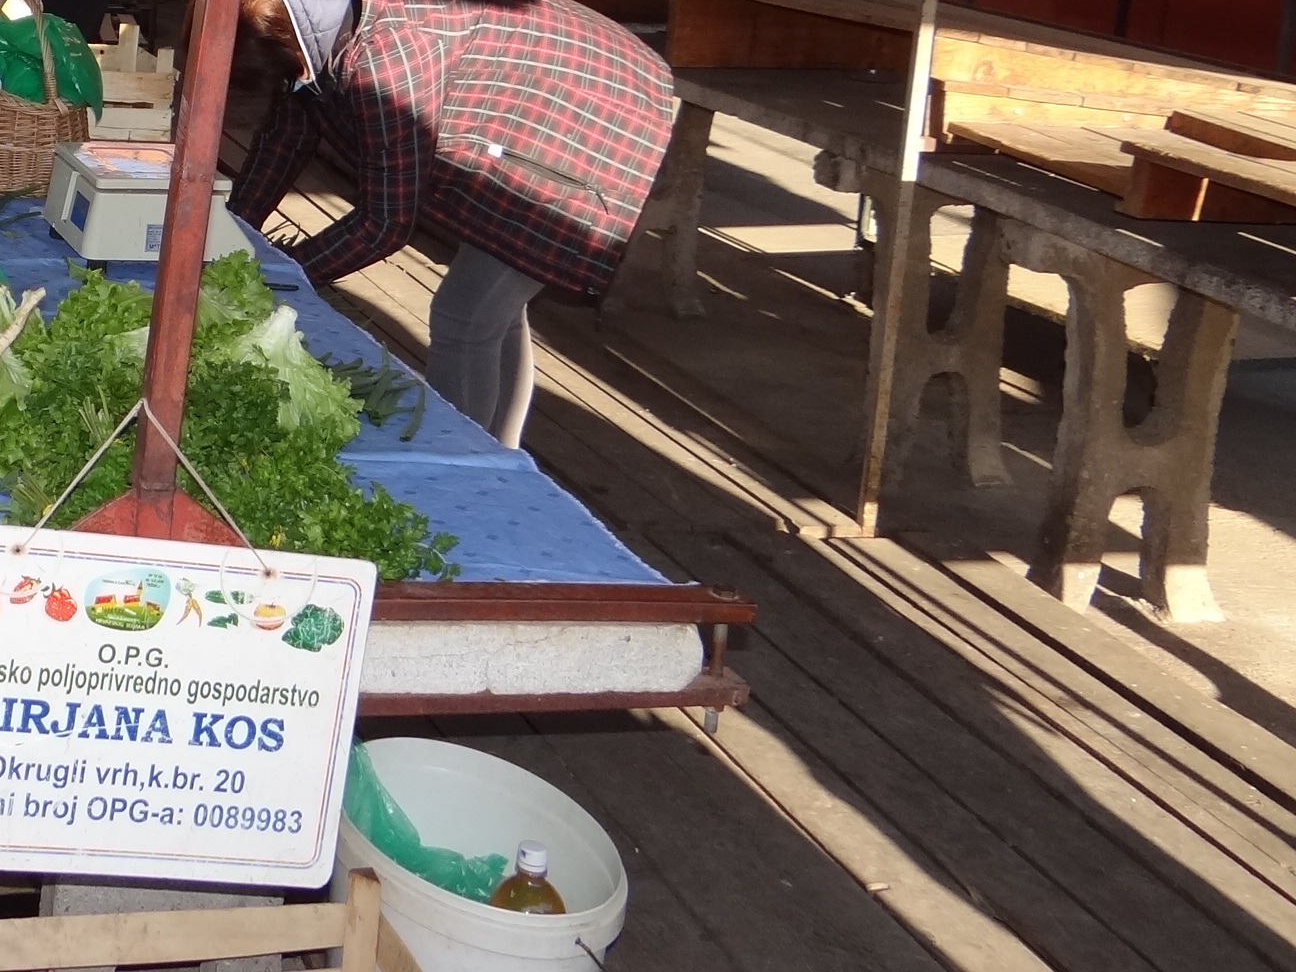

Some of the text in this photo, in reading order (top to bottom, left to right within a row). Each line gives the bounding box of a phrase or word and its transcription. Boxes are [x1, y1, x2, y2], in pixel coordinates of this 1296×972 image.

[98, 643, 169, 669] O.P.G.
[36, 662, 182, 697] poljoprivredno
[186, 679, 320, 707] gospodarstvo
[187, 711, 285, 753] KOS
[95, 761, 204, 792] vrh,k.br.
[213, 768, 246, 794] 20
[23, 792, 79, 826] broj
[86, 795, 184, 826] OPG-a:
[193, 802, 304, 834] 0089983
